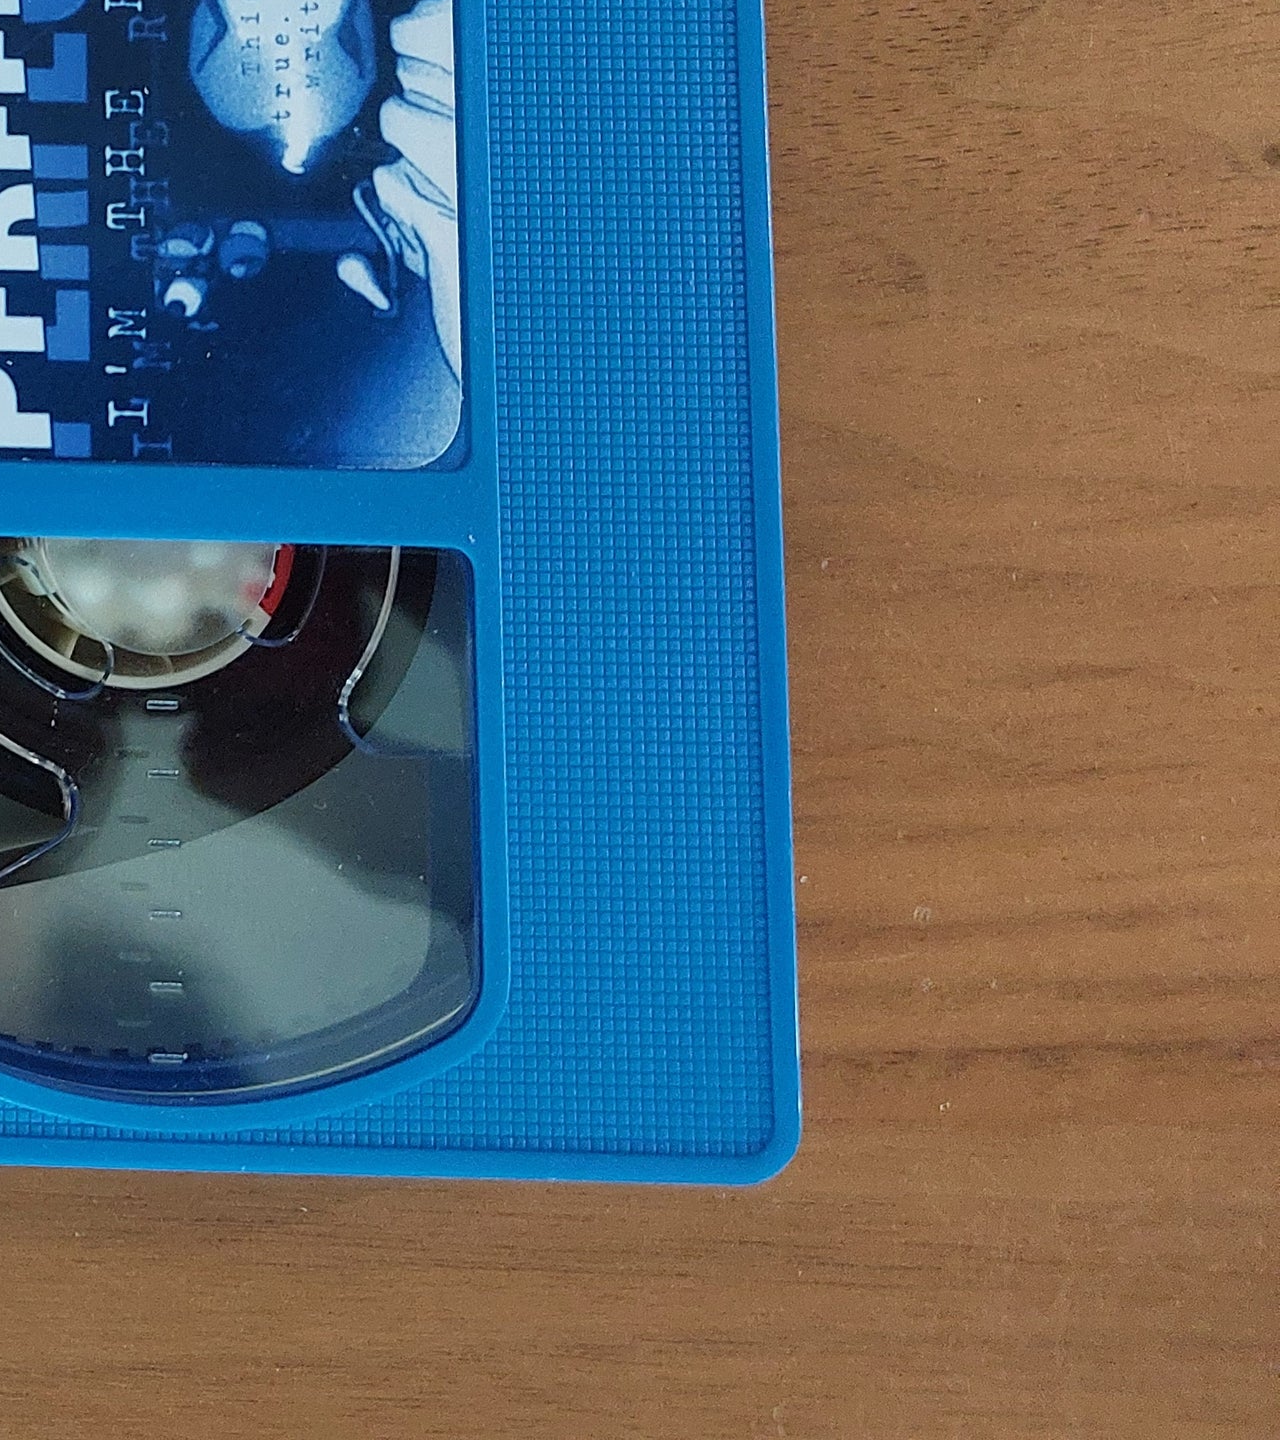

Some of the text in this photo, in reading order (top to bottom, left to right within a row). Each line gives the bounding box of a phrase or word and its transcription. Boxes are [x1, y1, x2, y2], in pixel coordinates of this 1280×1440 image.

[272, 16, 290, 121] true.
[105, 87, 145, 229] THE
[106, 306, 149, 426] I'M
